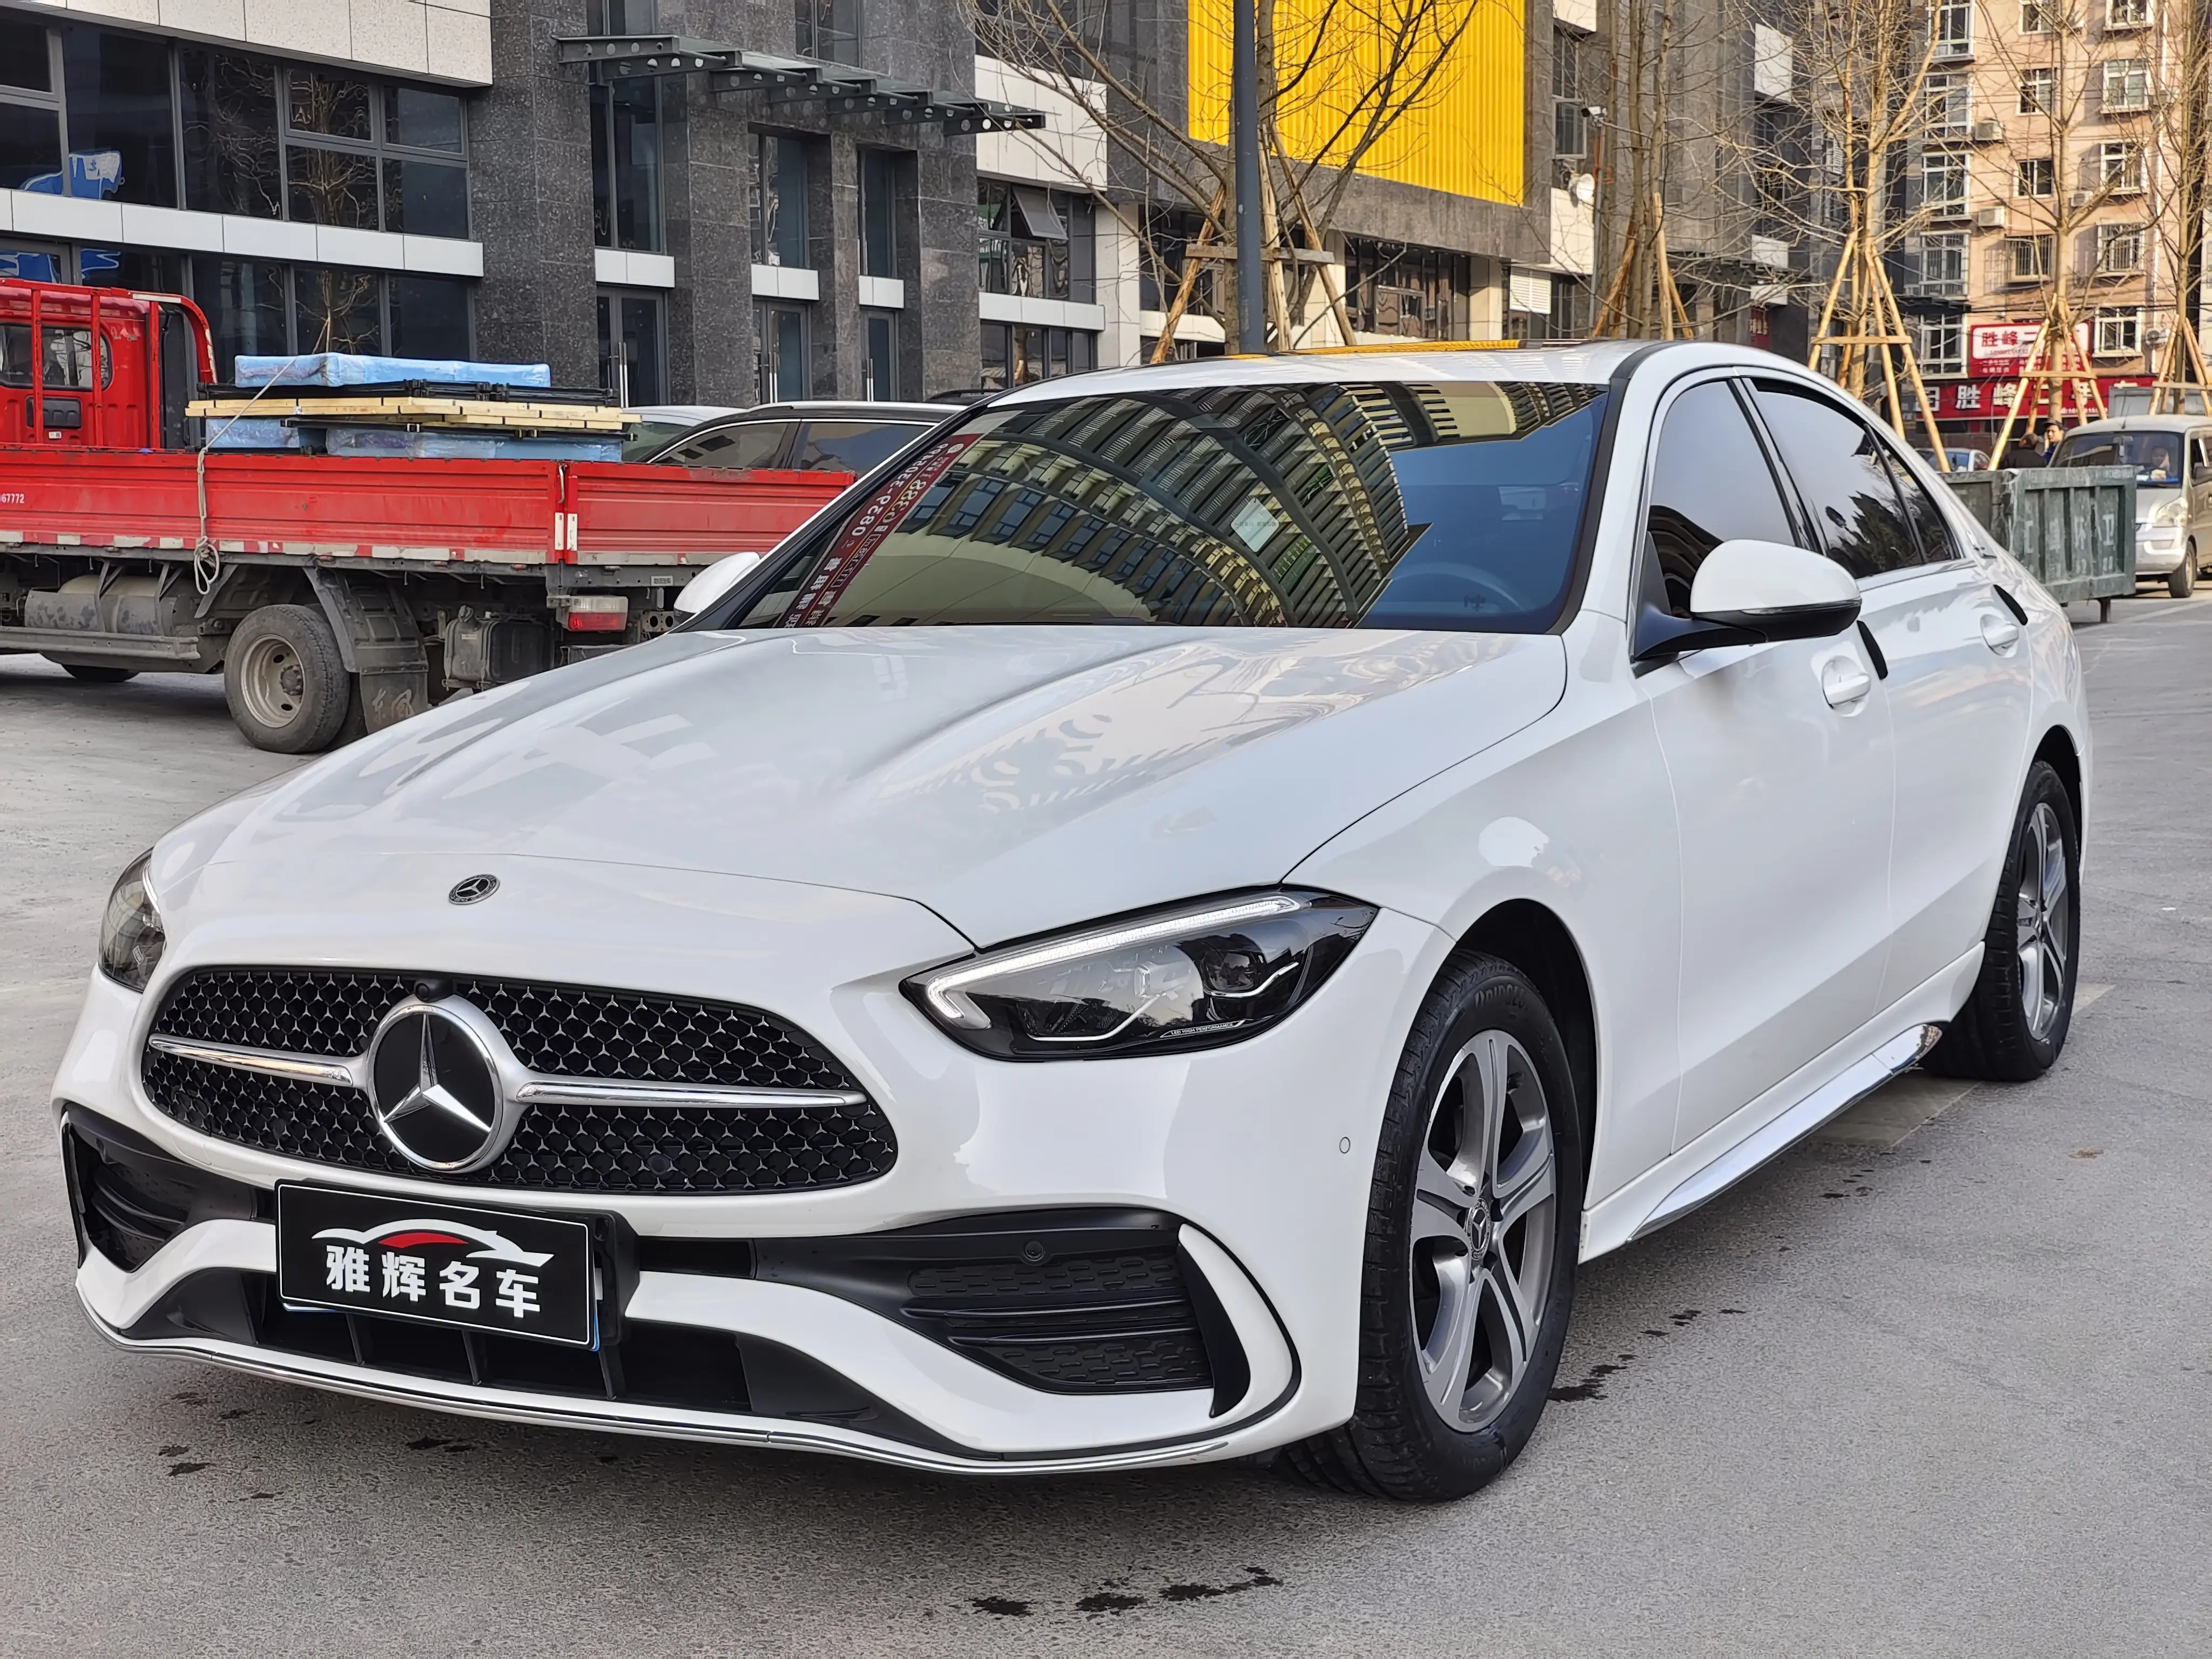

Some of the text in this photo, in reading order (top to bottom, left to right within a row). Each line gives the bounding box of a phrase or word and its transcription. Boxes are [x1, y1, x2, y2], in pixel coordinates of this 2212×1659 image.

[0, 493, 25, 504] 67772
[1196, 1023, 1233, 1031] PERFORMANCE
[326, 1245, 541, 1318] 雅辉名车
